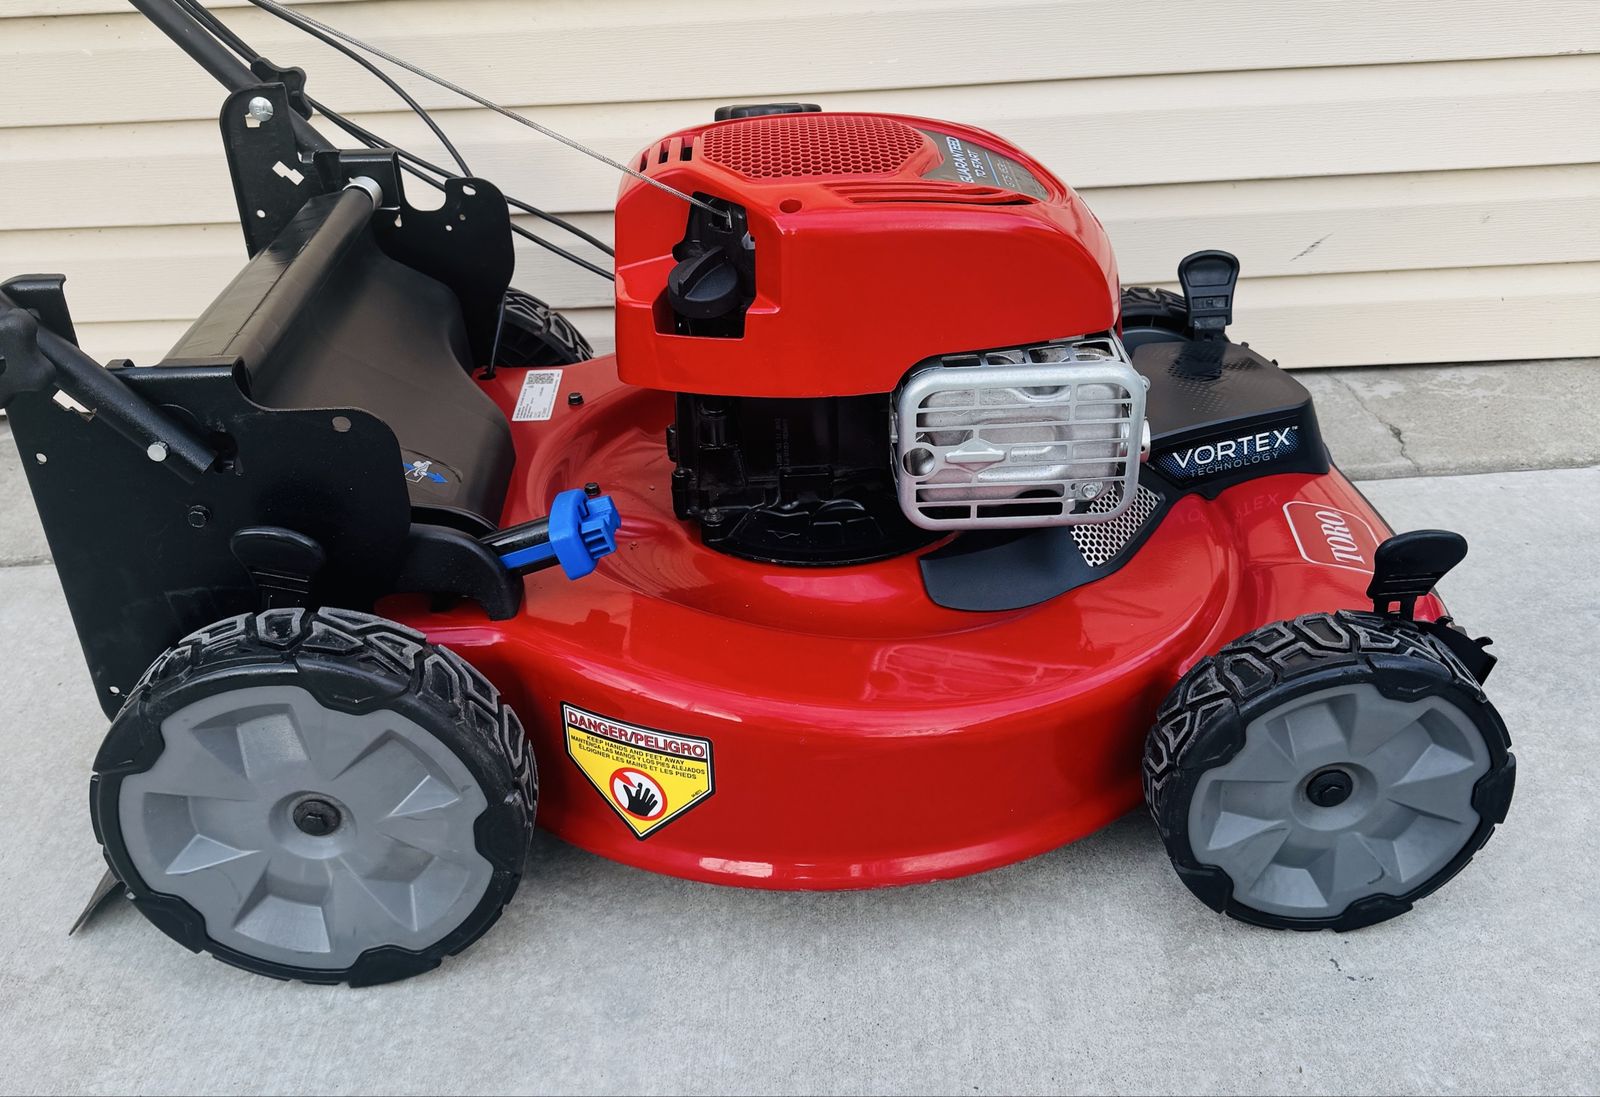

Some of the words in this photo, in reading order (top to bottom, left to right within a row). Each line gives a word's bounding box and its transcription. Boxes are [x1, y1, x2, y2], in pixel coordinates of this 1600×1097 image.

[946, 136, 975, 184] GUARANTEED
[1190, 451, 1280, 478] TECHNOLOGY
[1315, 510, 1366, 564] TORO
[567, 710, 705, 758] DANGER/PELIGRO
[570, 734, 601, 750] MANTENGA
[601, 746, 614, 755] LAS
[614, 749, 636, 760] MANOS
[642, 757, 655, 766] LOS
[656, 760, 671, 769] PIES
[671, 764, 706, 775] ALEJADOS
[586, 735, 604, 744] KEEP
[604, 741, 628, 752] HANDS
[629, 748, 644, 757] AND
[645, 752, 663, 761] FEET
[664, 757, 685, 766] AWAY
[611, 755, 625, 764] LES
[626, 759, 648, 770] MAINS
[659, 767, 674, 776] LES
[675, 770, 697, 780] PIEDS
